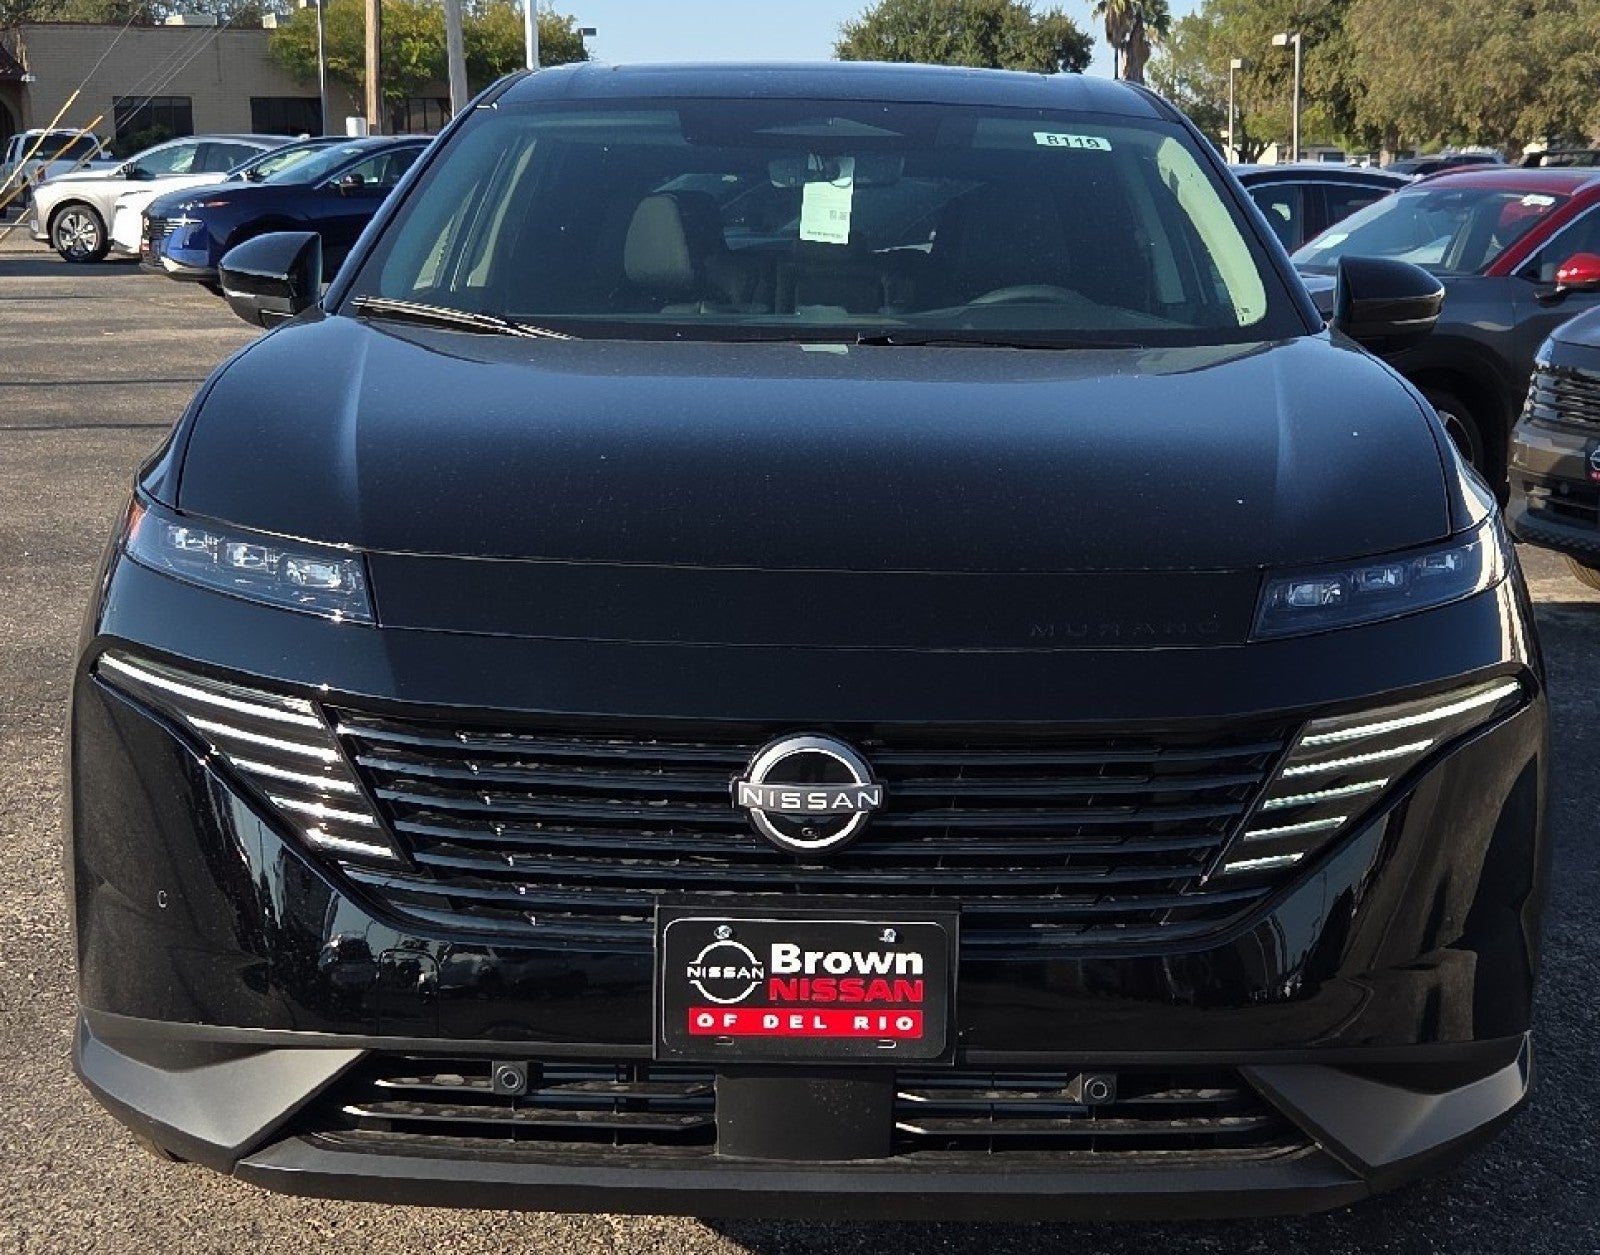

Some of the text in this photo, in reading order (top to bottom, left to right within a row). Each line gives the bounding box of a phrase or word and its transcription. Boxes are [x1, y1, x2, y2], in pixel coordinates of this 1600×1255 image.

[1030, 622, 1220, 637] MURANO
[743, 787, 879, 809] NISSAN
[771, 943, 924, 975] Brown
[686, 966, 765, 980] NISSAN
[768, 978, 924, 1002] NISSAN
[696, 1013, 914, 1031] OF DEL RIO
